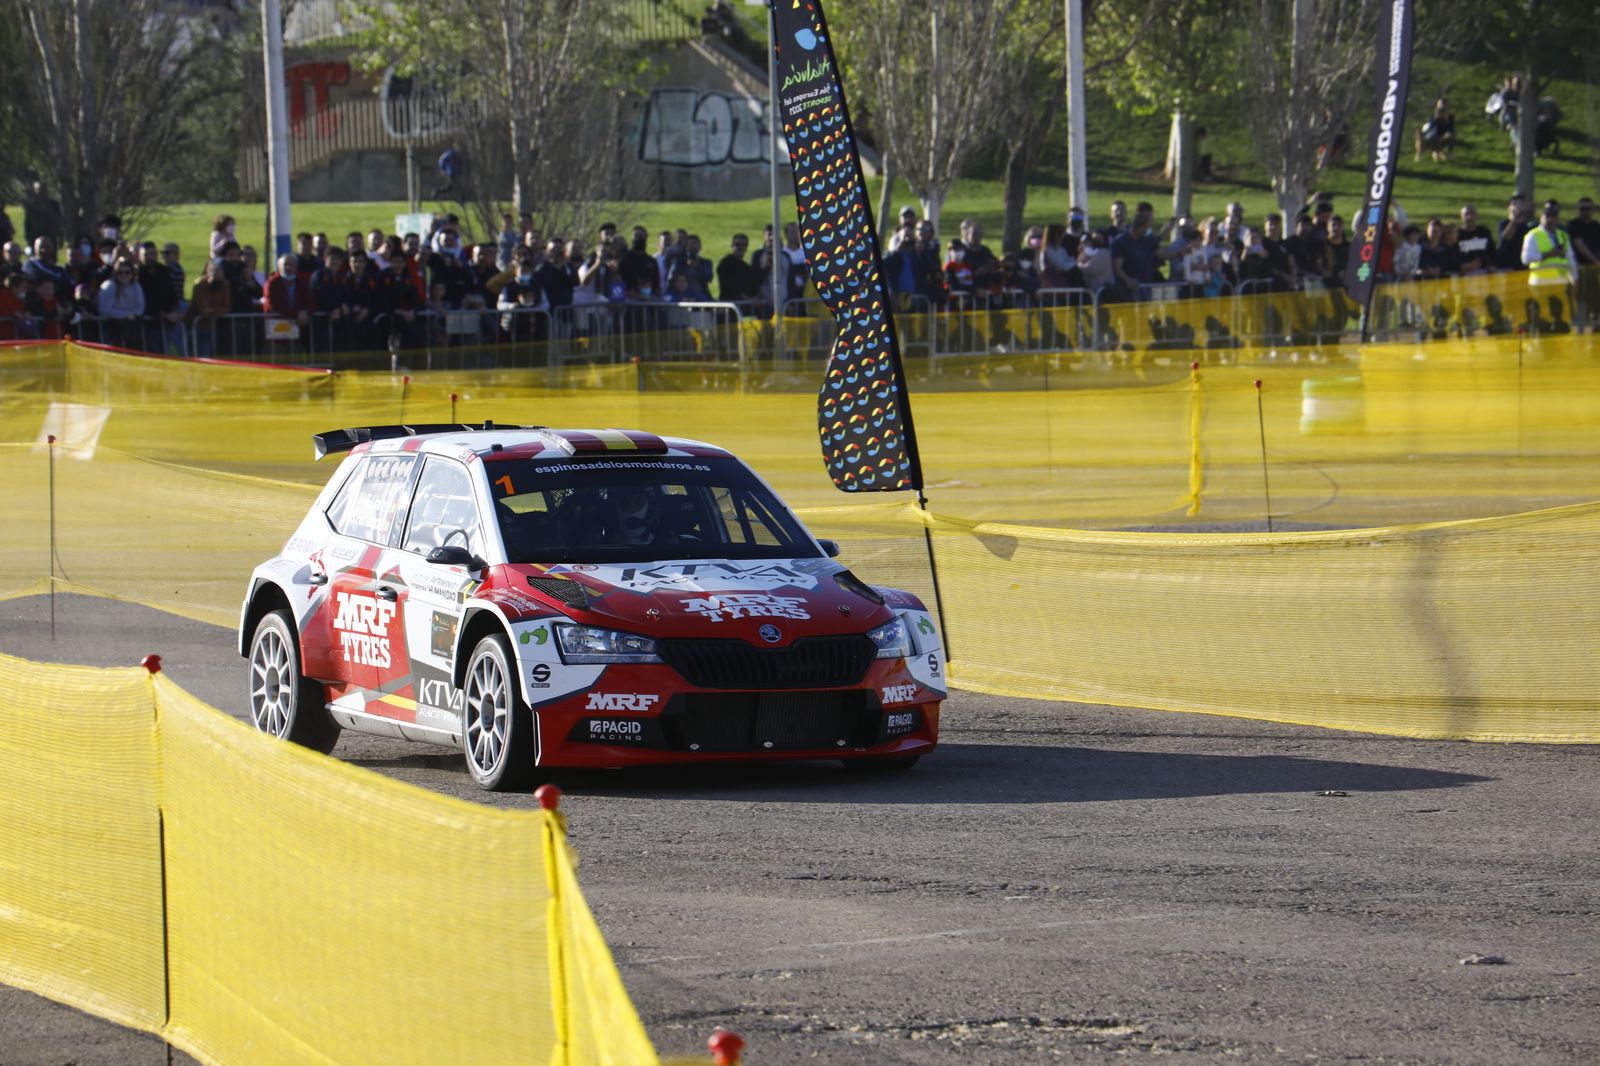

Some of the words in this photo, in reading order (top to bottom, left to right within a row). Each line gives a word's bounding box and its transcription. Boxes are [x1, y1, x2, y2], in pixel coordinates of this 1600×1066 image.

[535, 460, 711, 475] espinosadelosmonteros.es
[495, 474, 515, 495] 1
[679, 594, 809, 613] MRF
[333, 591, 397, 637] MRF
[699, 606, 812, 623] TYRES
[340, 631, 392, 670] TYRES
[585, 692, 659, 711] MRF
[882, 684, 917, 704] MRF
[602, 720, 642, 734] PAGID
[590, 733, 642, 741] RACING
